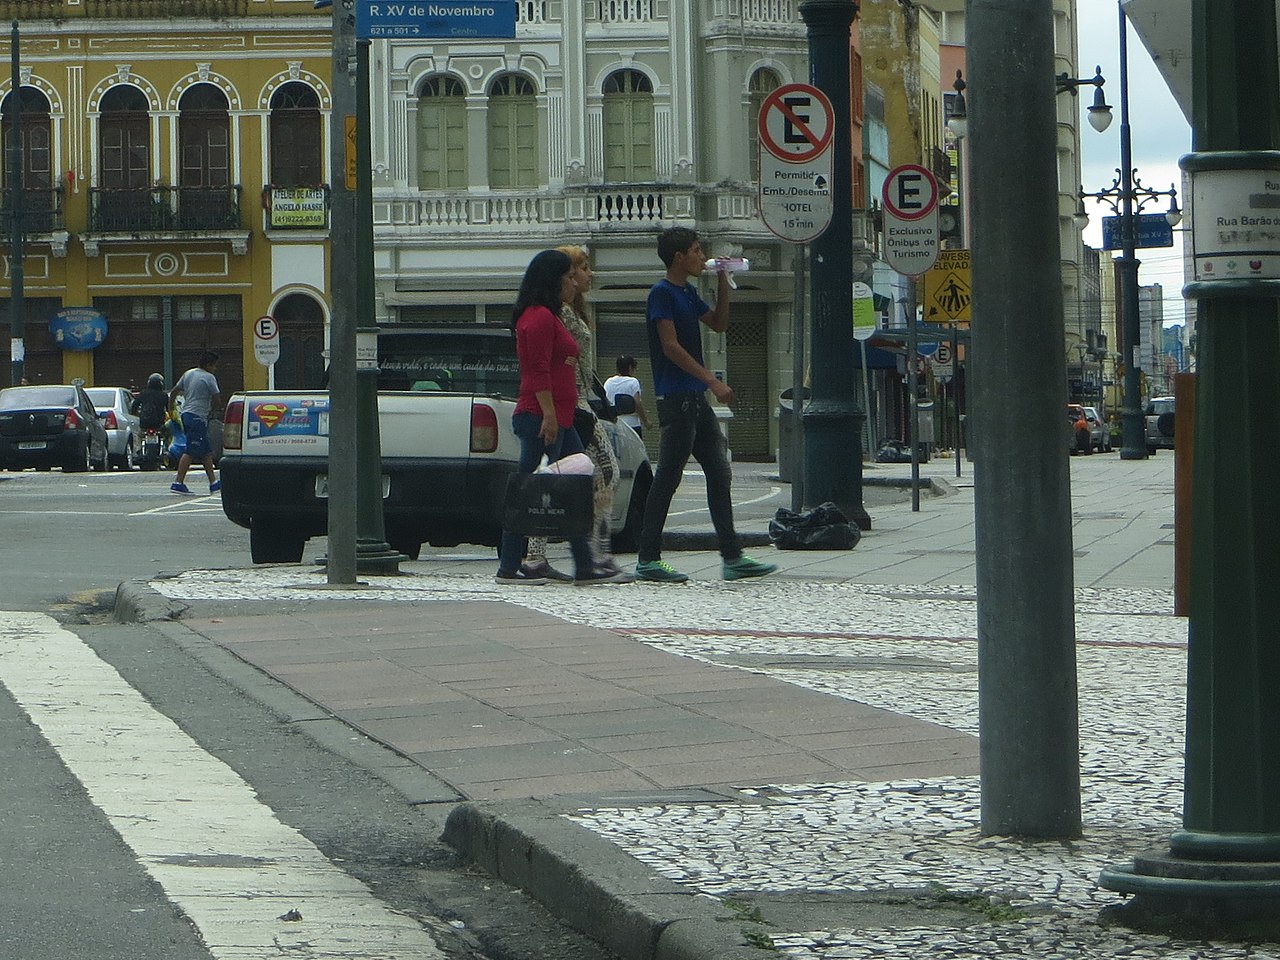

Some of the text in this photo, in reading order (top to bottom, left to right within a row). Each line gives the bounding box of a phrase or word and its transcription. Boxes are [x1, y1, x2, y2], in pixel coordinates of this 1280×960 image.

[370, 5, 495, 16] R. XV de Novembro
[898, 174, 922, 209] E
[274, 203, 301, 211] ANGELO
[782, 220, 795, 228] 15
[1217, 217, 1237, 226] Rua
[1241, 216, 1272, 226] Barão
[889, 228, 933, 236] Exclusivo
[923, 238, 935, 246] de
[893, 249, 930, 258] Turismo
[933, 261, 970, 270] ELEVAD
[260, 320, 271, 335] E
